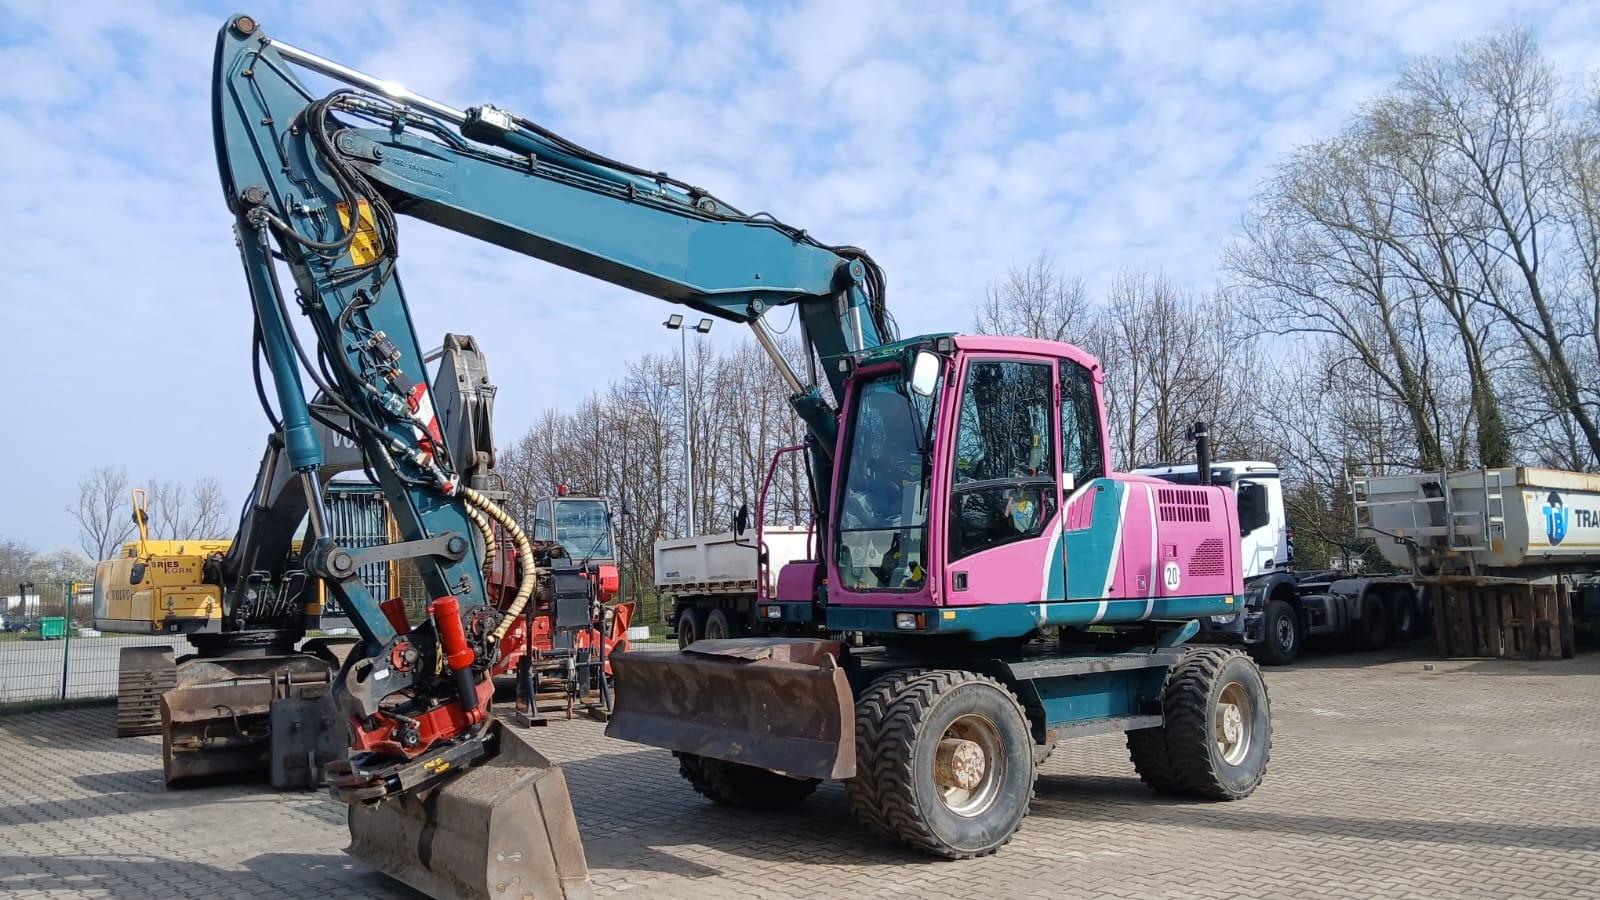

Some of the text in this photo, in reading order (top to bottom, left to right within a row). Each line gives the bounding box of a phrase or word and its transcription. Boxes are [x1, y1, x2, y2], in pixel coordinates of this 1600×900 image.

[332, 428, 359, 449] VO
[1575, 509, 1600, 528] TRA
[1166, 567, 1178, 585] 20
[112, 588, 130, 600] VOLVO
